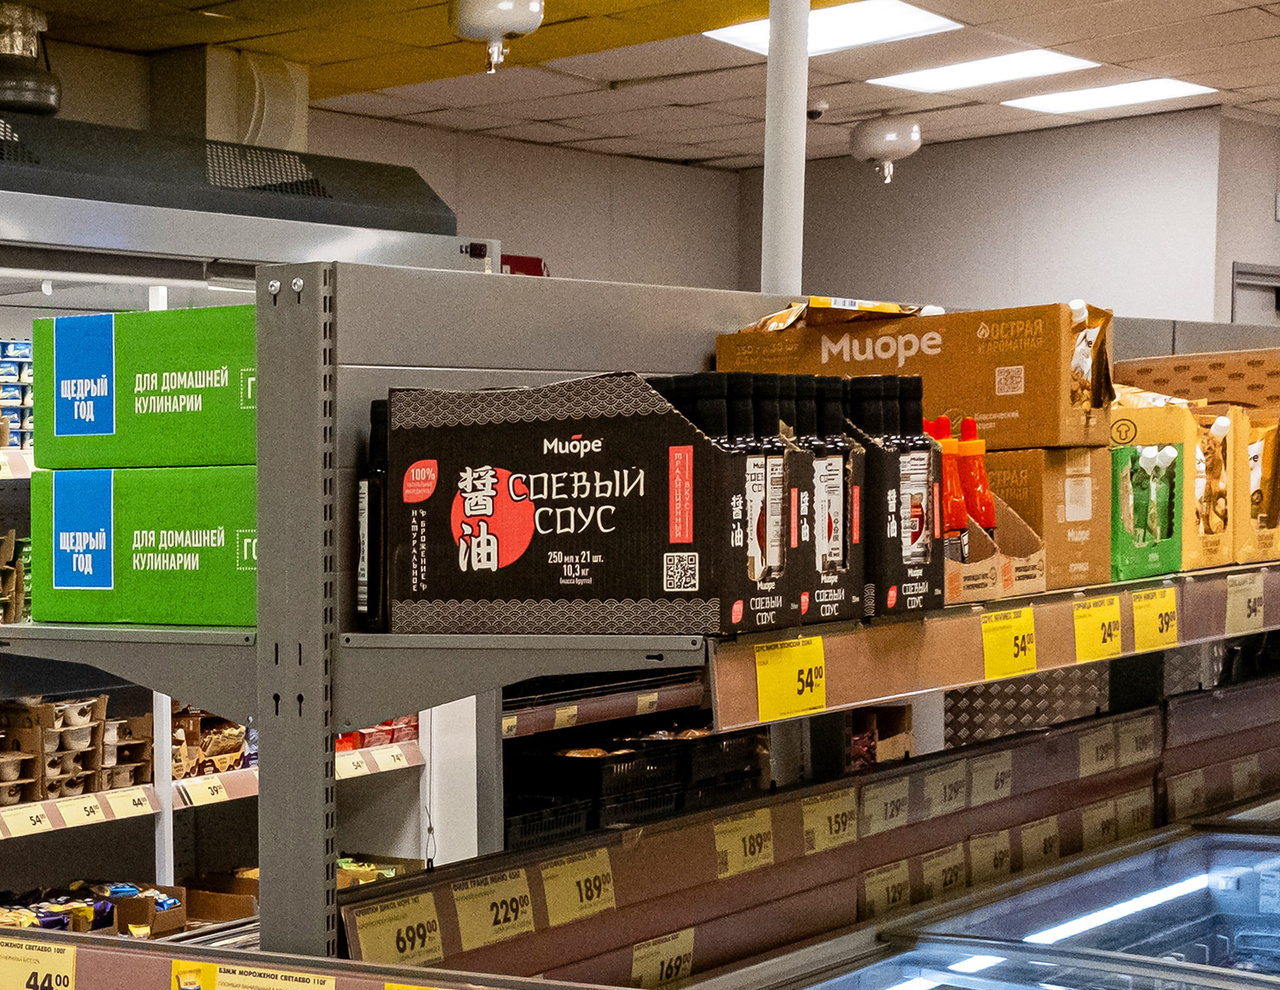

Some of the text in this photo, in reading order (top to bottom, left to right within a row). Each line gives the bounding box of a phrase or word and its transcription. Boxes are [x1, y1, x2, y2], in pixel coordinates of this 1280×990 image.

[60, 375, 108, 401] ЩЕДРЫЙ
[134, 373, 158, 393] ДЛЯ
[161, 366, 229, 392] ДОМАШНЕЙ
[74, 401, 94, 422] ГОД
[134, 395, 203, 414] КУЛИНАРИИ
[411, 467, 435, 481] 100%
[508, 467, 644, 501] СОЕВЫЙ
[535, 505, 616, 534] СОУС
[59, 528, 106, 553] ЩЕДРЫЙ
[132, 530, 156, 550] ДЛЯ
[159, 526, 225, 549] ДОМАШНЕЙ
[72, 553, 93, 575] ГОД
[133, 553, 199, 571] КУЛИНАРИИ
[548, 551, 563, 563] 250
[581, 551, 590, 562] 21
[562, 564, 589, 577] 10,3 кг
[750, 596, 783, 610] СОЕВЫЙ
[815, 589, 845, 603] СОЕВЫЙ
[756, 611, 775, 625] СОУС
[820, 604, 839, 617] СОУС
[25, 944, 52, 952] СВЕТАЕВО
[238, 970, 278, 981] МОРОЖЕНОЕ
[280, 975, 310, 984] СВЕТАЕВО
